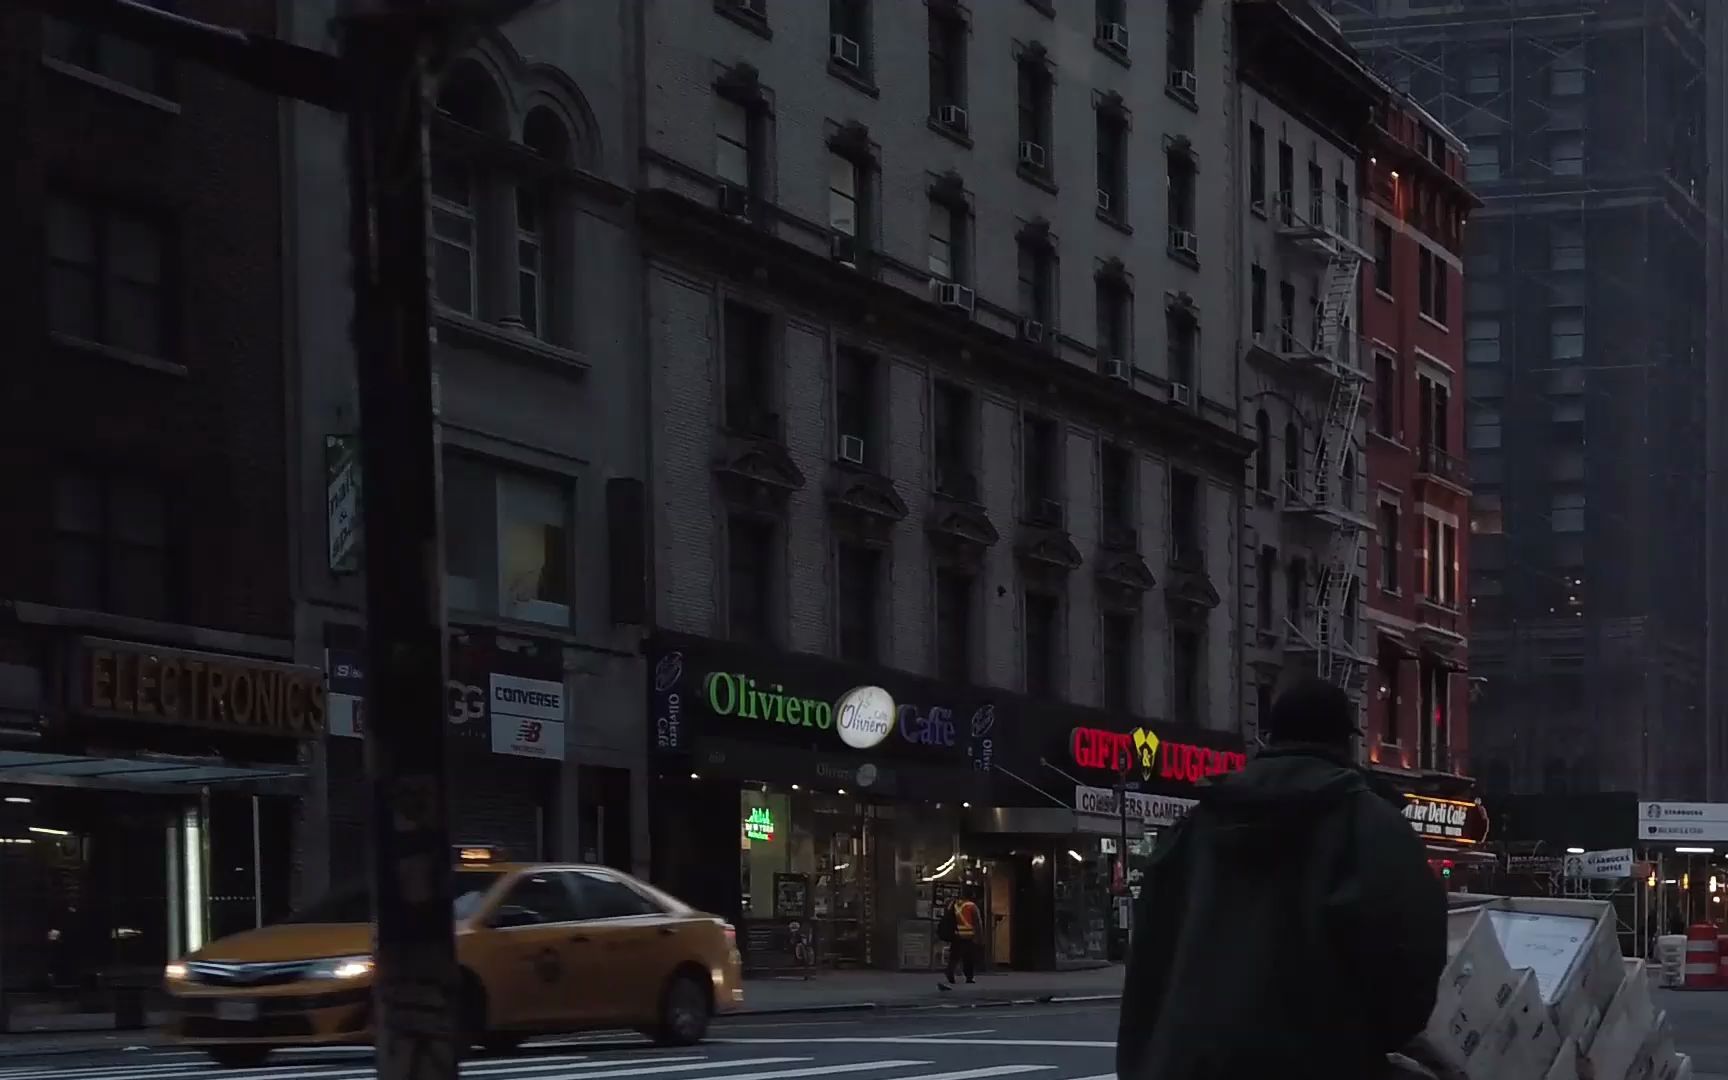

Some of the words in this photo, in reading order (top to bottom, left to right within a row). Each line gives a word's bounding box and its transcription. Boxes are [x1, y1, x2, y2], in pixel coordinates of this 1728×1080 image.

[93, 652, 325, 732] ELECTRONICS
[448, 680, 485, 724] GG
[495, 687, 560, 708] CONVERSE
[704, 672, 832, 730] Oliviero
[668, 693, 680, 748] Oliviero
[840, 701, 888, 734] Oliviero
